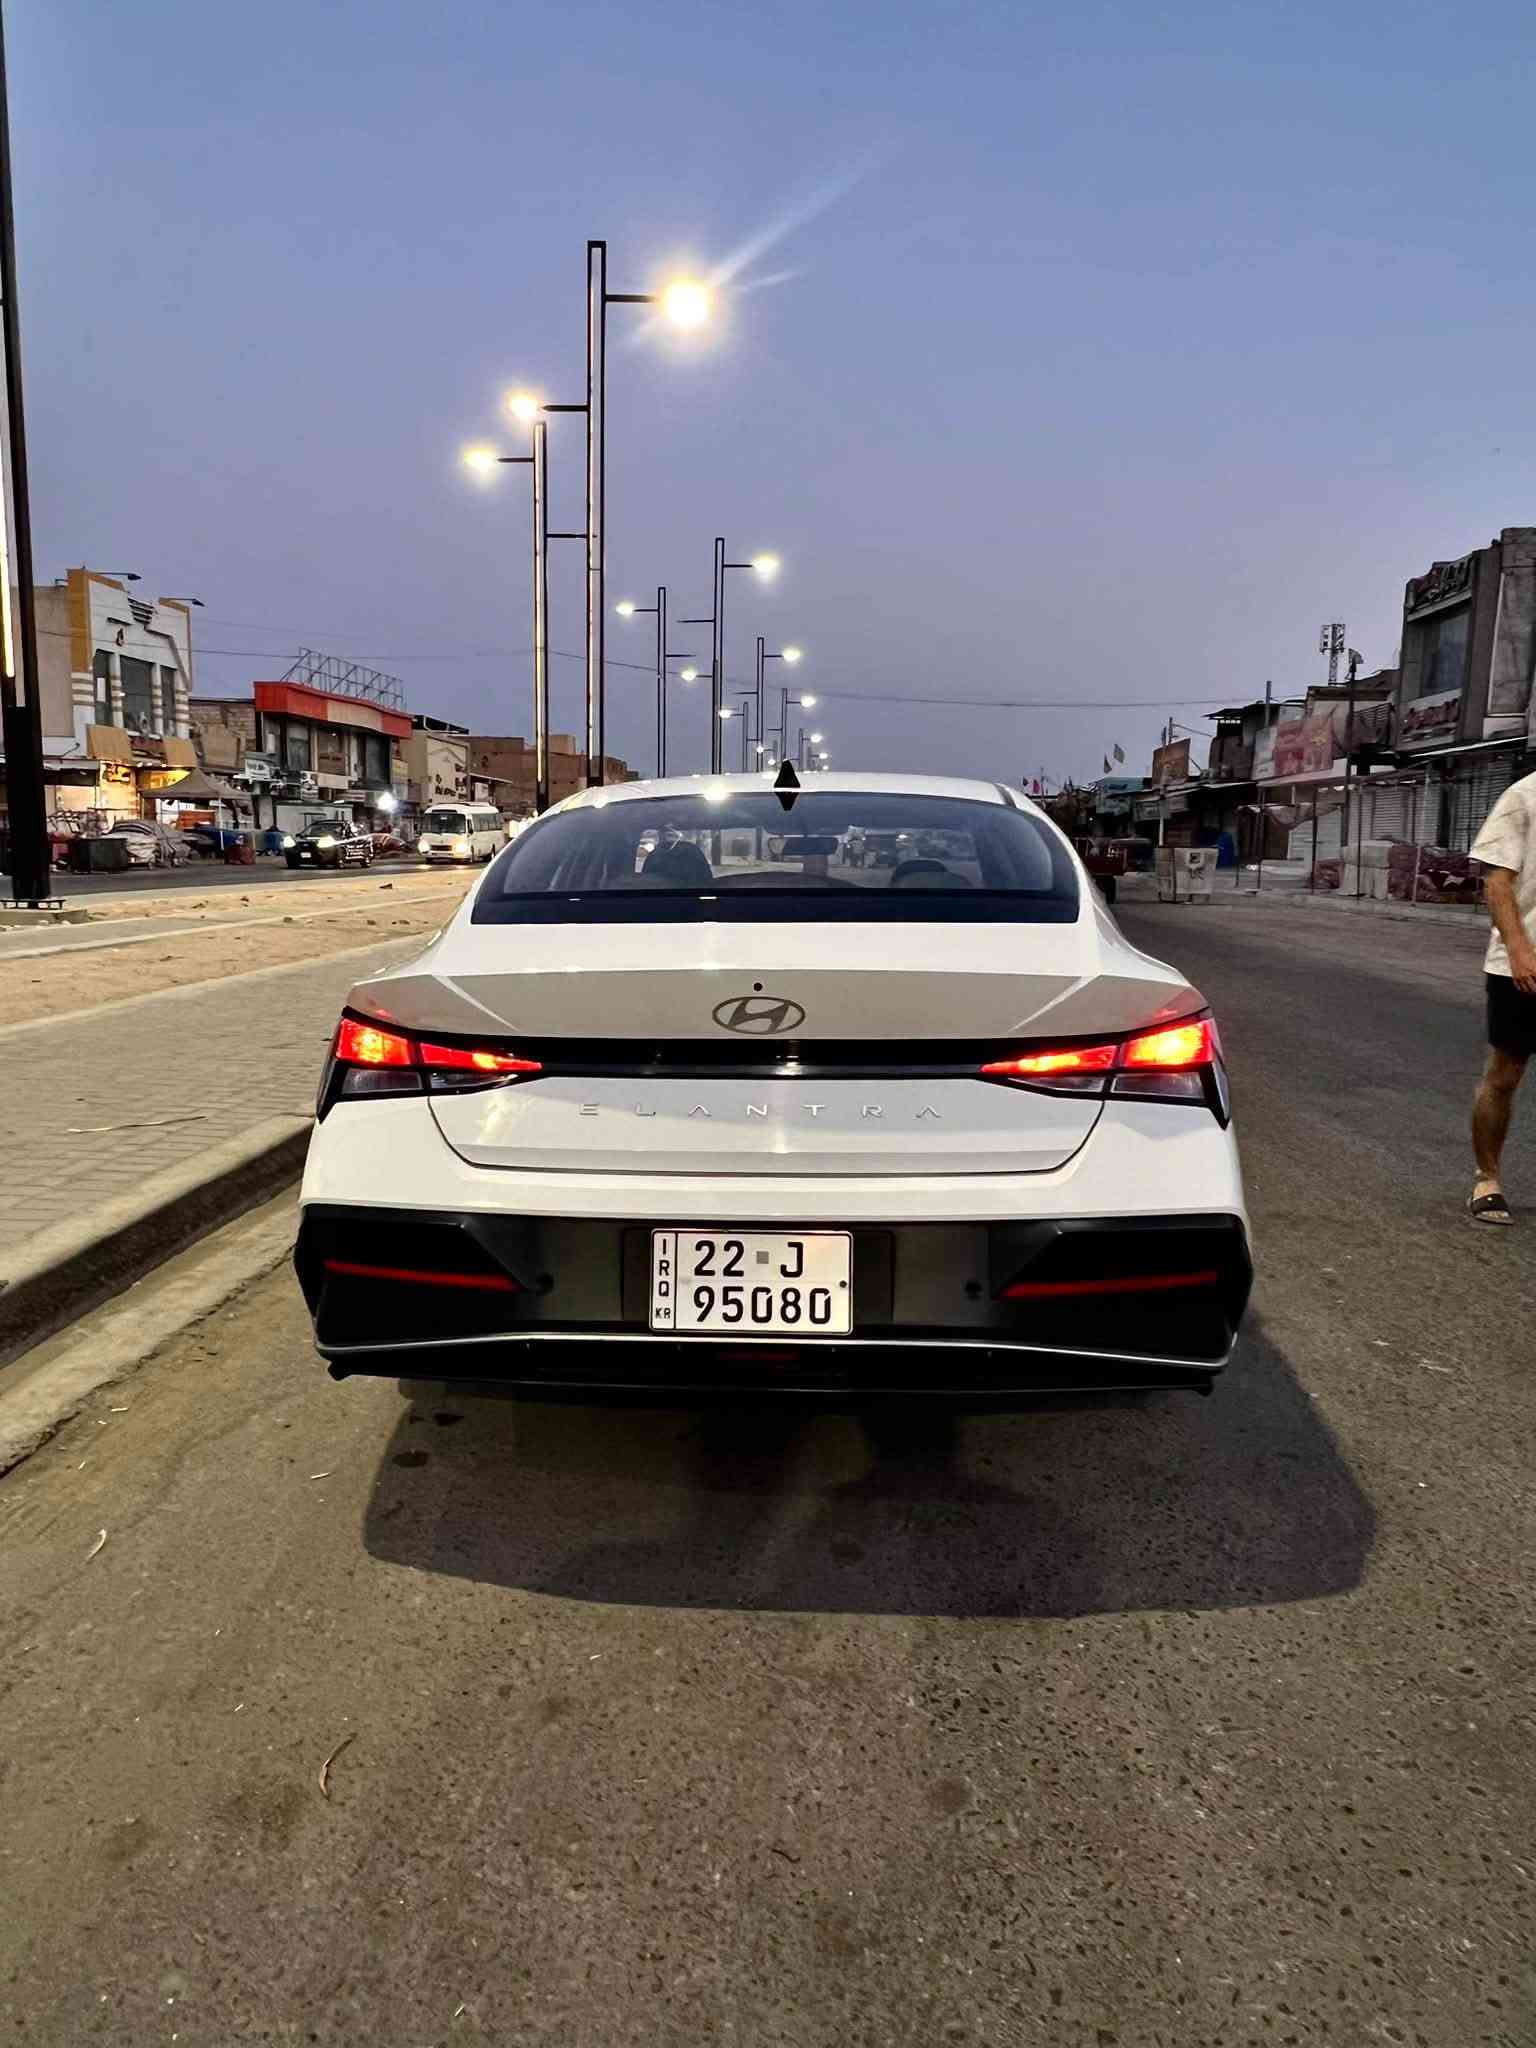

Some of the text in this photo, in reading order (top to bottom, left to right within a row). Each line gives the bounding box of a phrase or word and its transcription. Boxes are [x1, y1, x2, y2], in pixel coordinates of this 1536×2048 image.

[578, 1102, 942, 1120] ELANTRA
[657, 1238, 671, 1298] IRQ
[693, 1239, 805, 1279] 22 J
[692, 1285, 833, 1326] 95080
